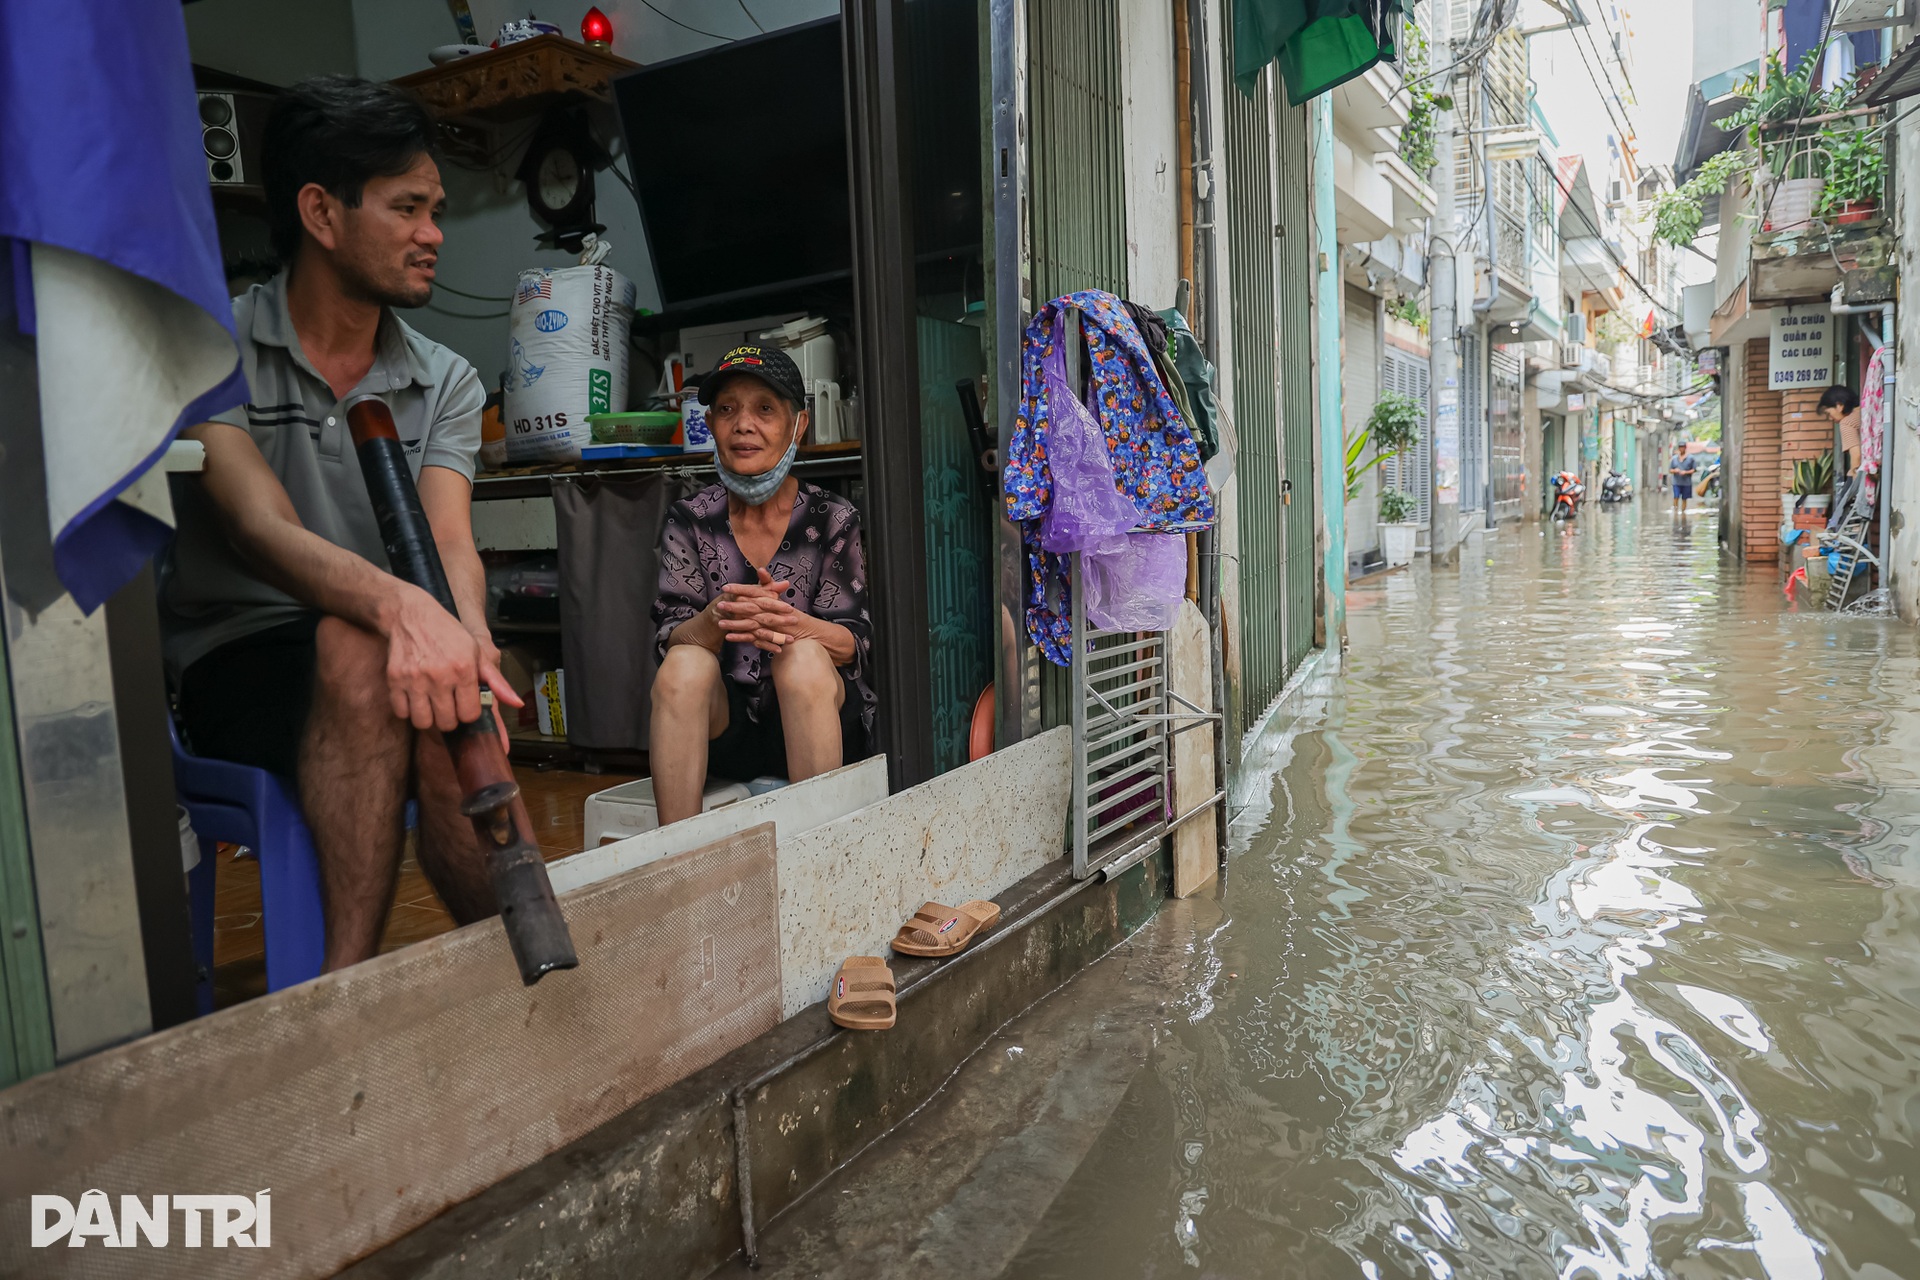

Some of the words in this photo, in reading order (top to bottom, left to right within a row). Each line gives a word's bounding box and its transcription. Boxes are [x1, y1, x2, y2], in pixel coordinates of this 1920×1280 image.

[593, 297, 601, 315] CHO
[724, 346, 761, 360] GUCCI
[1802, 347, 1822, 359] LOẠI
[1774, 370, 1795, 383] 0349
[1796, 369, 1812, 382] 269
[1813, 368, 1828, 381] 287
[592, 372, 609, 409] 31S
[513, 418, 531, 434] HD
[534, 412, 568, 431] 31S
